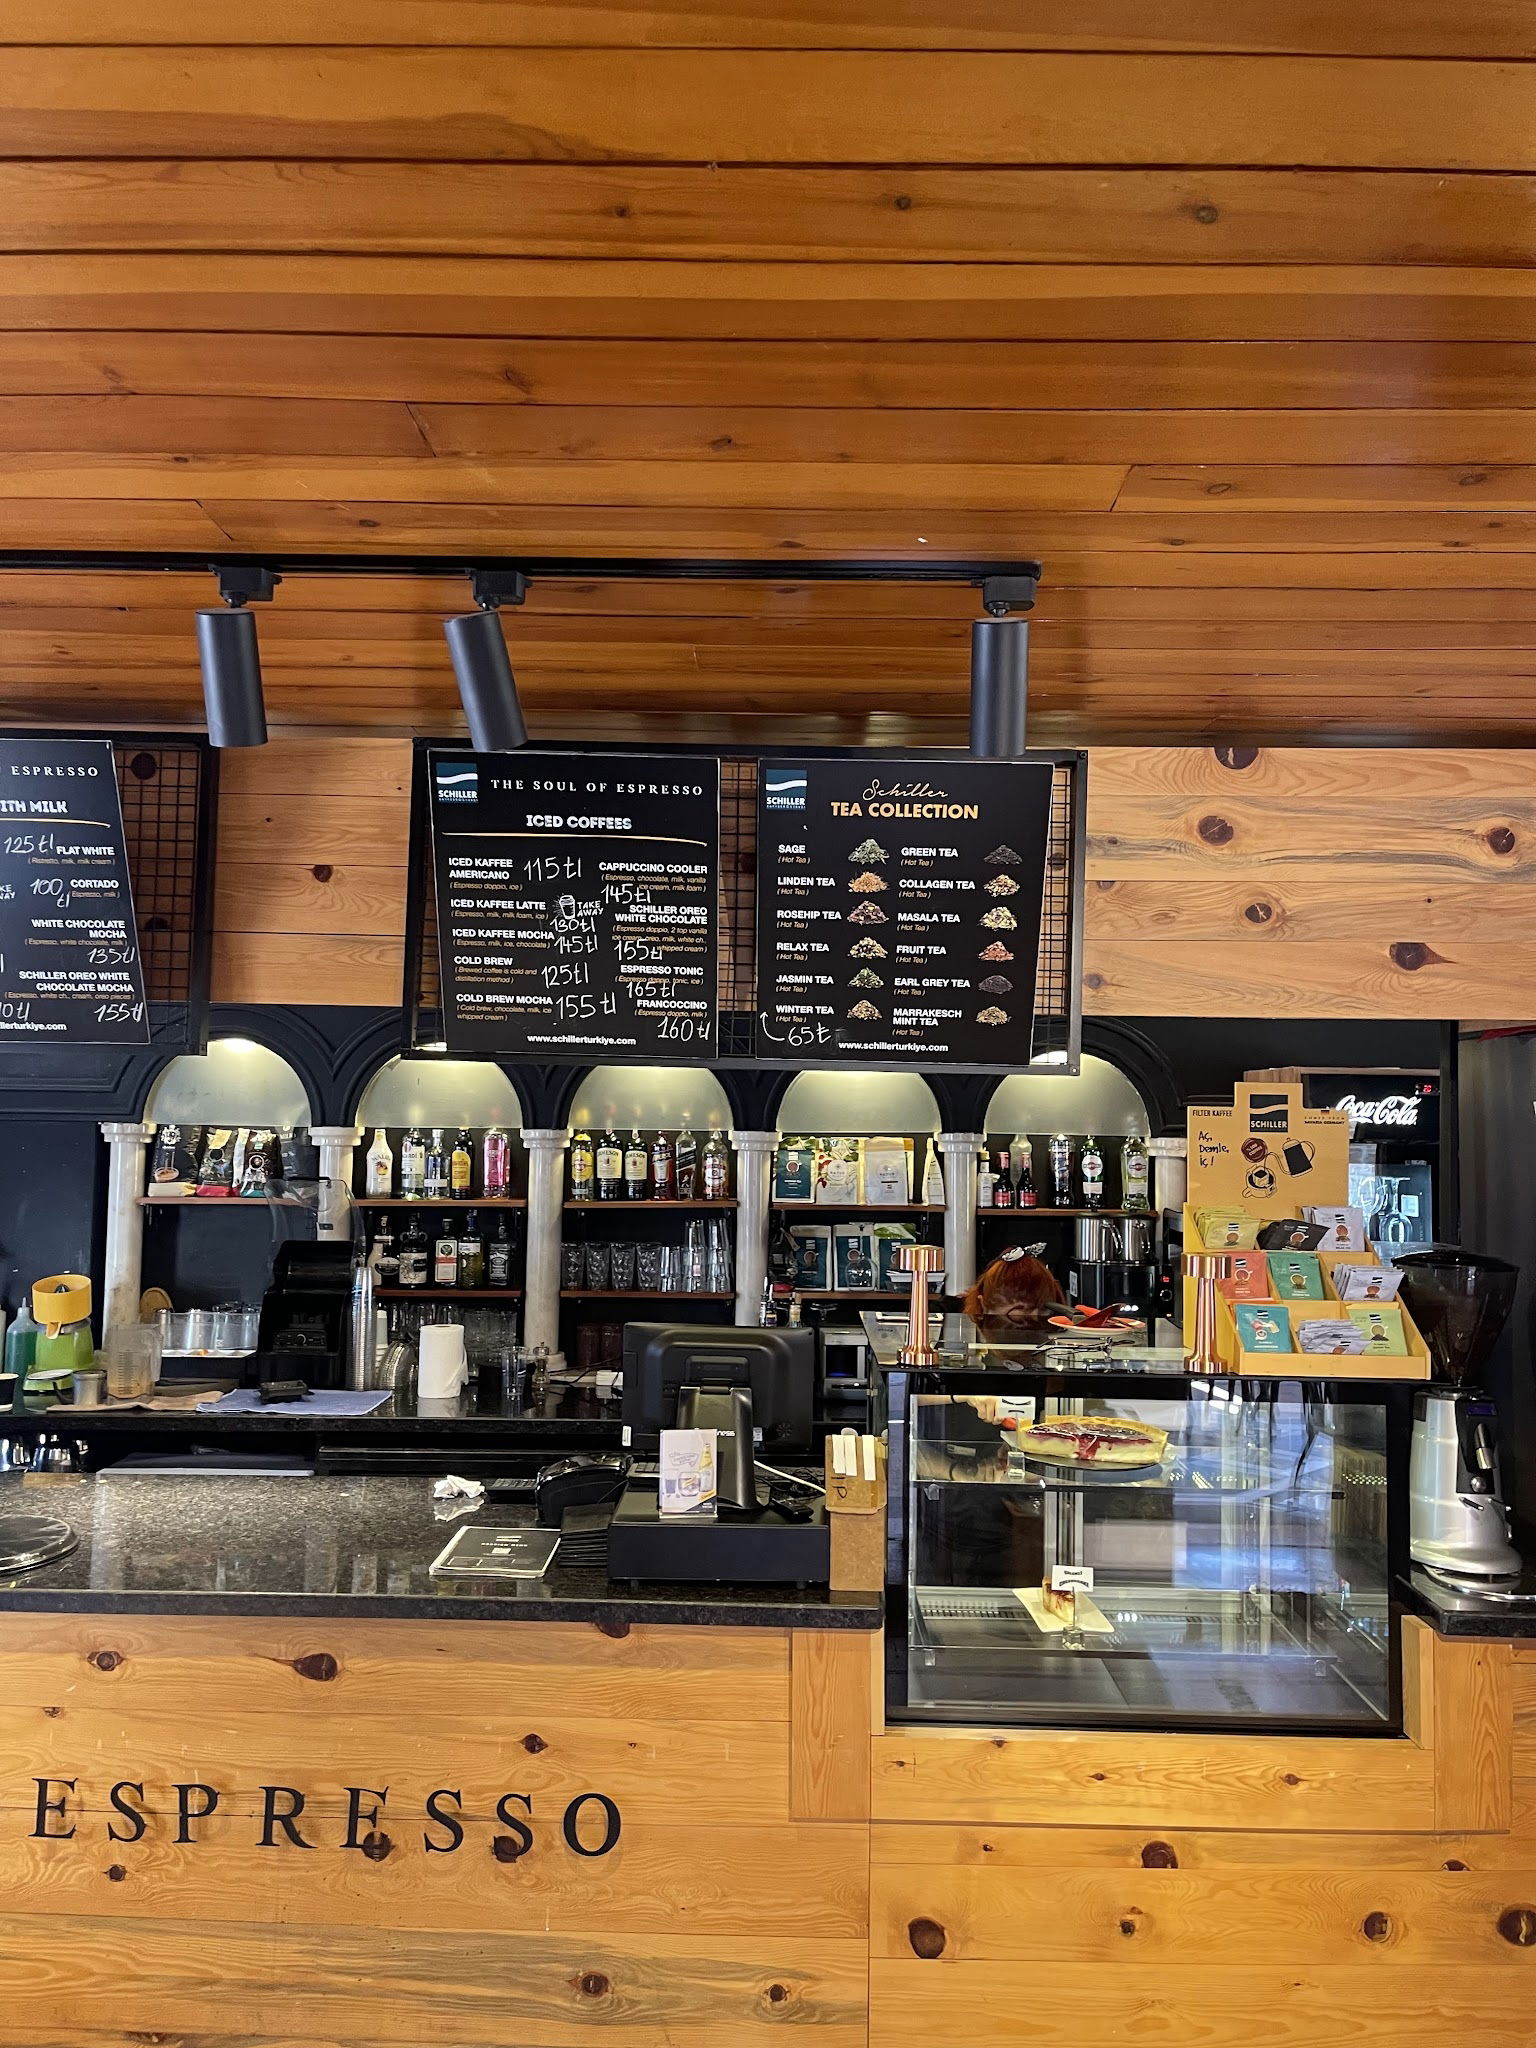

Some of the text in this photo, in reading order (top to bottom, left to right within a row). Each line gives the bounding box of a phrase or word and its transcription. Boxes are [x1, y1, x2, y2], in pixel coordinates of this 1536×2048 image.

[11, 765, 98, 777] ESPRESSO
[490, 779, 703, 796] THE SOUL OF ESPRESSO
[862, 778, 949, 801] Schiller
[438, 790, 478, 799] SCHILLER
[766, 796, 806, 805] SCHILLER
[0, 800, 69, 814] ITH MILK
[831, 801, 979, 819] TEA COLLECTION
[525, 814, 633, 830] ICED COFFEES
[56, 846, 115, 856] FLAT WHITE
[777, 844, 806, 854] SAGE
[901, 847, 958, 857] GREEN TEA
[448, 857, 514, 868] ICED KAFFEE
[599, 862, 708, 874] CAPPUCCINO COOLER
[449, 869, 510, 880] AMERICANO
[29, 878, 63, 896] 100
[70, 879, 119, 889] CORTADO
[777, 876, 836, 887] LINDEN TEA
[898, 879, 976, 890] COLLAGEN TEA
[450, 899, 547, 910] ICED KAFFEE LATTE
[577, 900, 602, 909] TAKE
[629, 904, 708, 916] SCHILLER OREO
[577, 908, 604, 918] AWAY
[776, 909, 842, 920] ROSEHIP TEA
[897, 912, 961, 923] MASALA TEA
[31, 919, 125, 929] WHITE CHOCOLATE
[615, 913, 708, 925] WHITE CHOCOLATE
[89, 929, 127, 939] MOCHA
[452, 928, 555, 940] ICED KAFFEE MOCHA
[776, 942, 830, 952] RELAX TEA
[896, 945, 947, 955] FRUIT TEA
[453, 955, 514, 966] COLD BREW
[19, 970, 130, 981] SCHILLER OREO WHITE
[620, 964, 704, 976] ESPRESSO TONIC
[776, 974, 834, 985] JASMIN TEA
[894, 977, 971, 988] EARL GREY TEA
[36, 983, 135, 992] CHOCOLATE MOCHA
[456, 994, 554, 1005] COLD BREW MOCHA
[636, 999, 708, 1009] FRANCOCCINO
[776, 1004, 835, 1015] WINTER TEA
[893, 1008, 963, 1018] MARRAKESCH
[892, 1017, 939, 1026] MINT TEA
[527, 1035, 637, 1046] www.schillerturkiye.com
[838, 1041, 949, 1053] www.schillerturkiye.com
[1192, 1109, 1211, 1117] FILTER
[1335, 1095, 1422, 1126] Coca-Cola
[1250, 1120, 1288, 1129] SCHILLER
[27, 1776, 622, 1858] ESPRESSO
